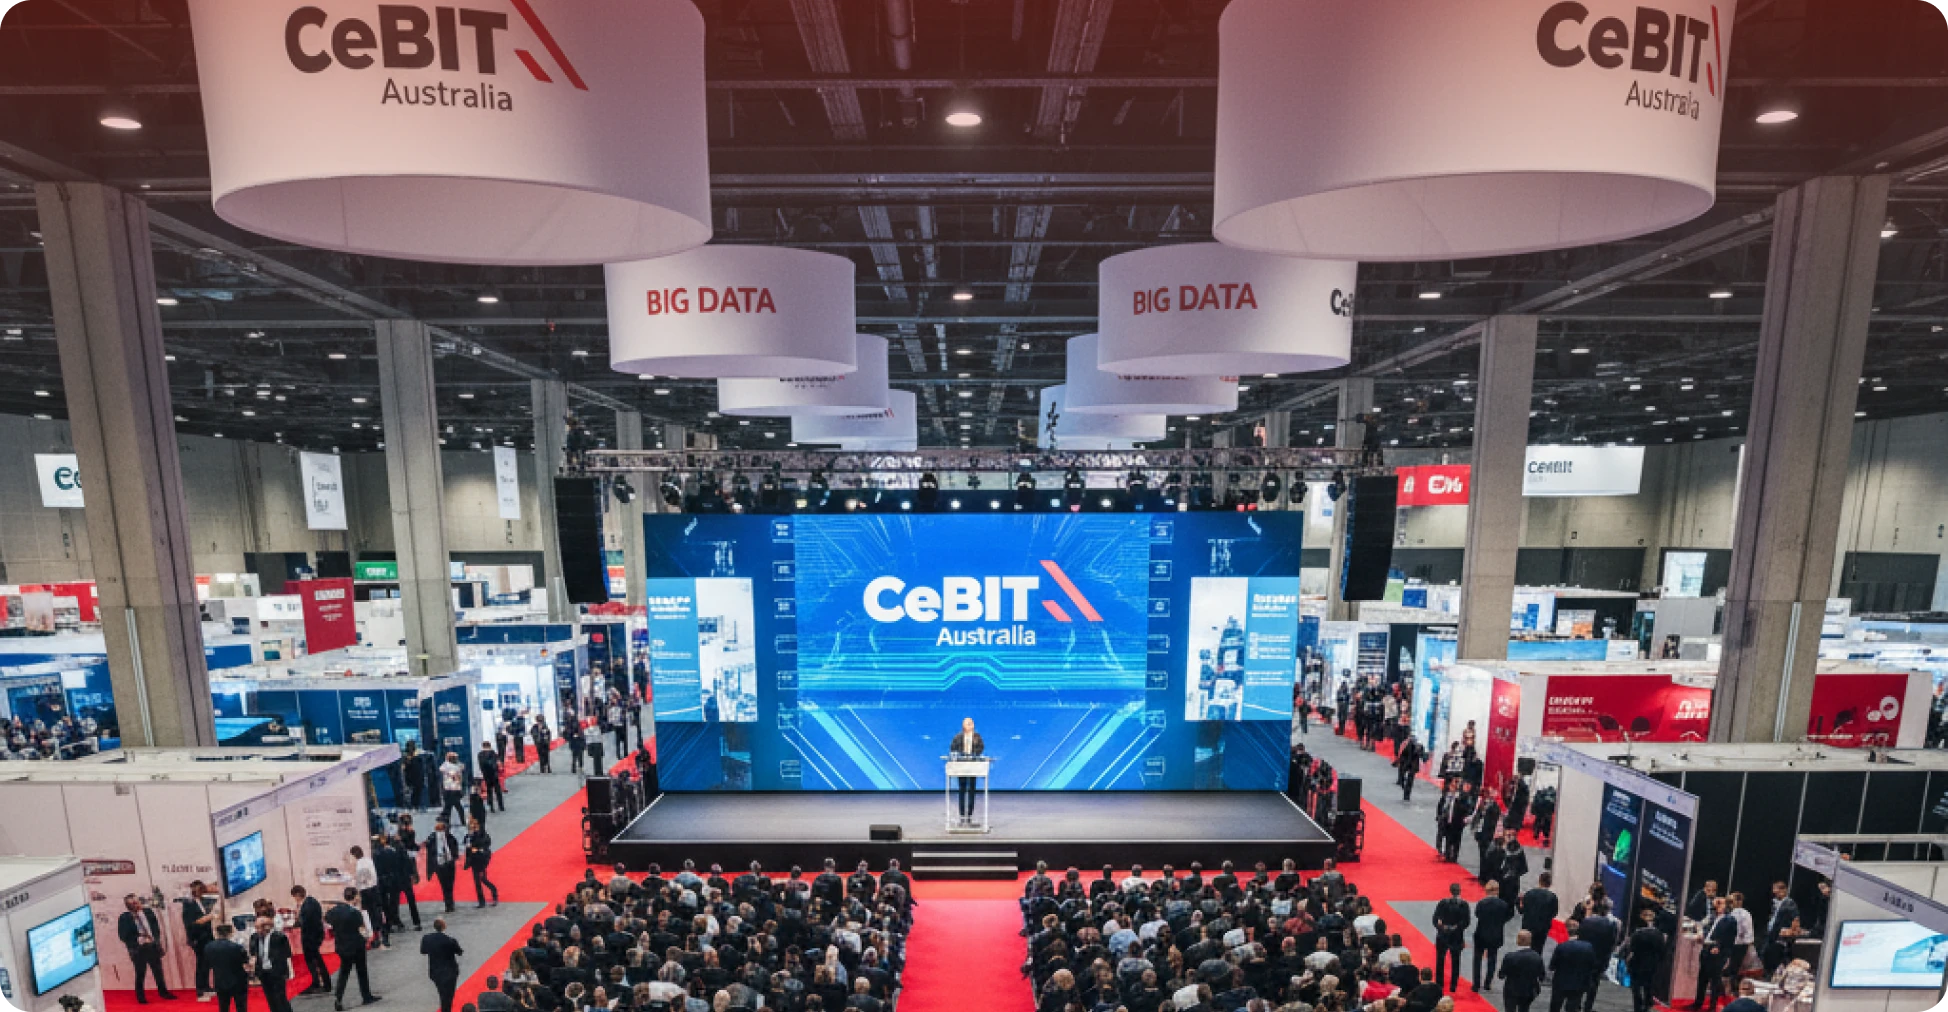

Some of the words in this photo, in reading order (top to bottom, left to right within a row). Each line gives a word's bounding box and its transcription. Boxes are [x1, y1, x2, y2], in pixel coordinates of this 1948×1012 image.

[285, 4, 508, 75] CeBIT
[1537, 1, 1710, 83] CeBIT
[381, 78, 513, 111] Australia
[647, 287, 690, 315] BIG
[698, 286, 777, 314] DATA
[1133, 286, 1171, 316] BIG
[1179, 282, 1258, 311] DATA
[863, 575, 1040, 622] CeBIT
[936, 624, 1036, 646] Australia
